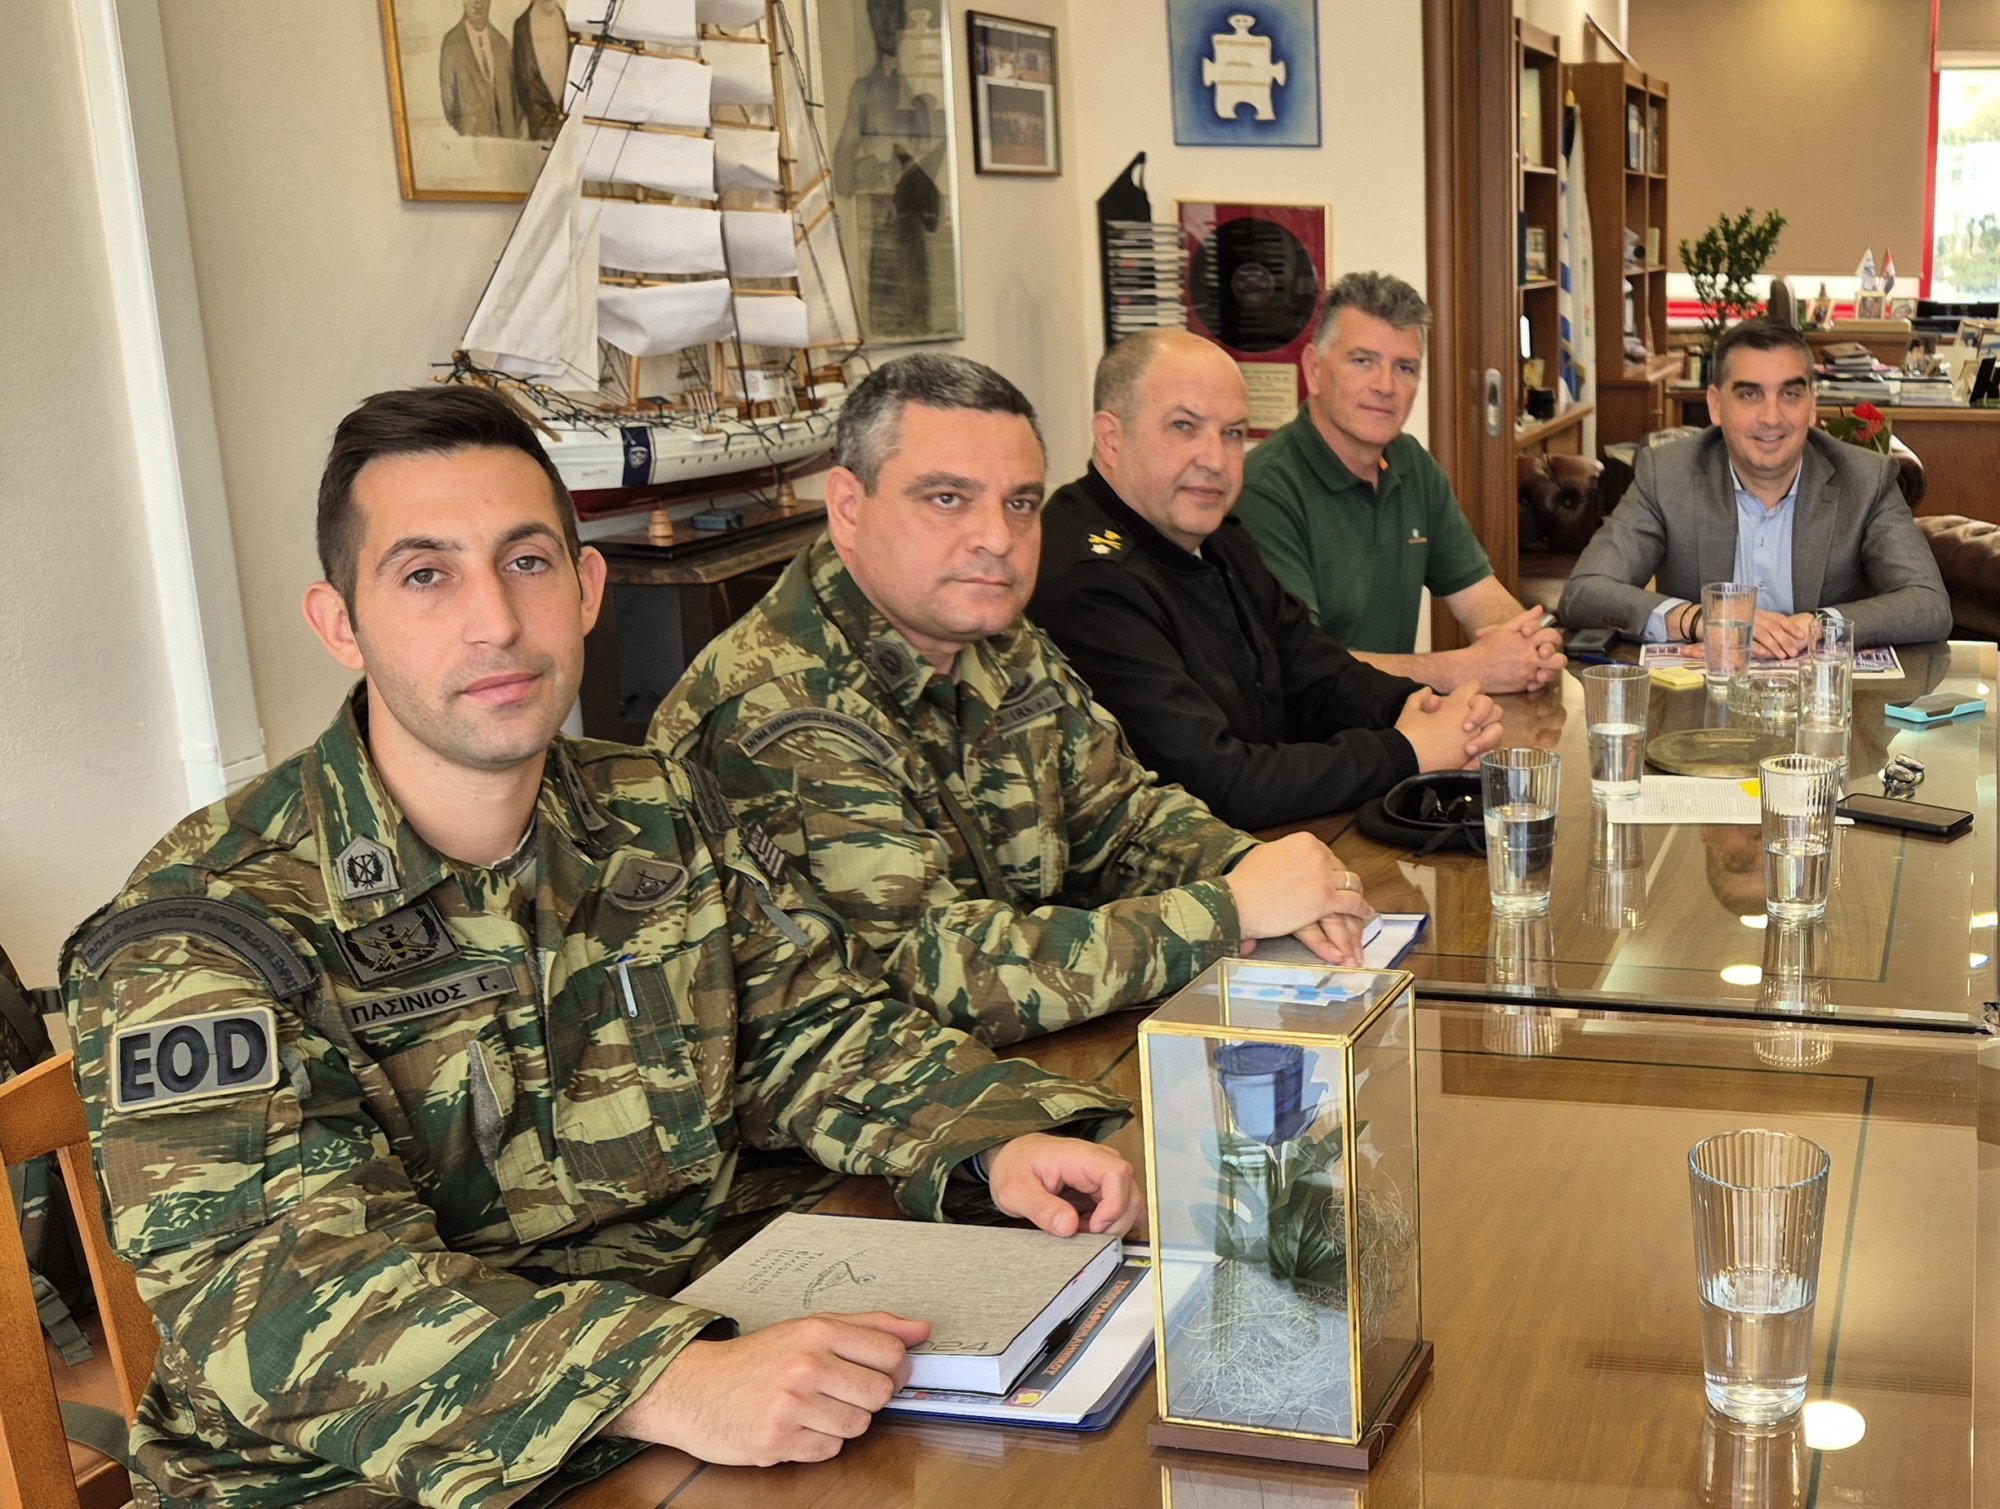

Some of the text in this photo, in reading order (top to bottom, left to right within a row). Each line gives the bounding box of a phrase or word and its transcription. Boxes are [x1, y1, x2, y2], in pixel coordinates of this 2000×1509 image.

[350, 975, 499, 1025] ΠΑΣΙΝΙΟΣ Γ.
[119, 1017, 268, 1103] EOD
